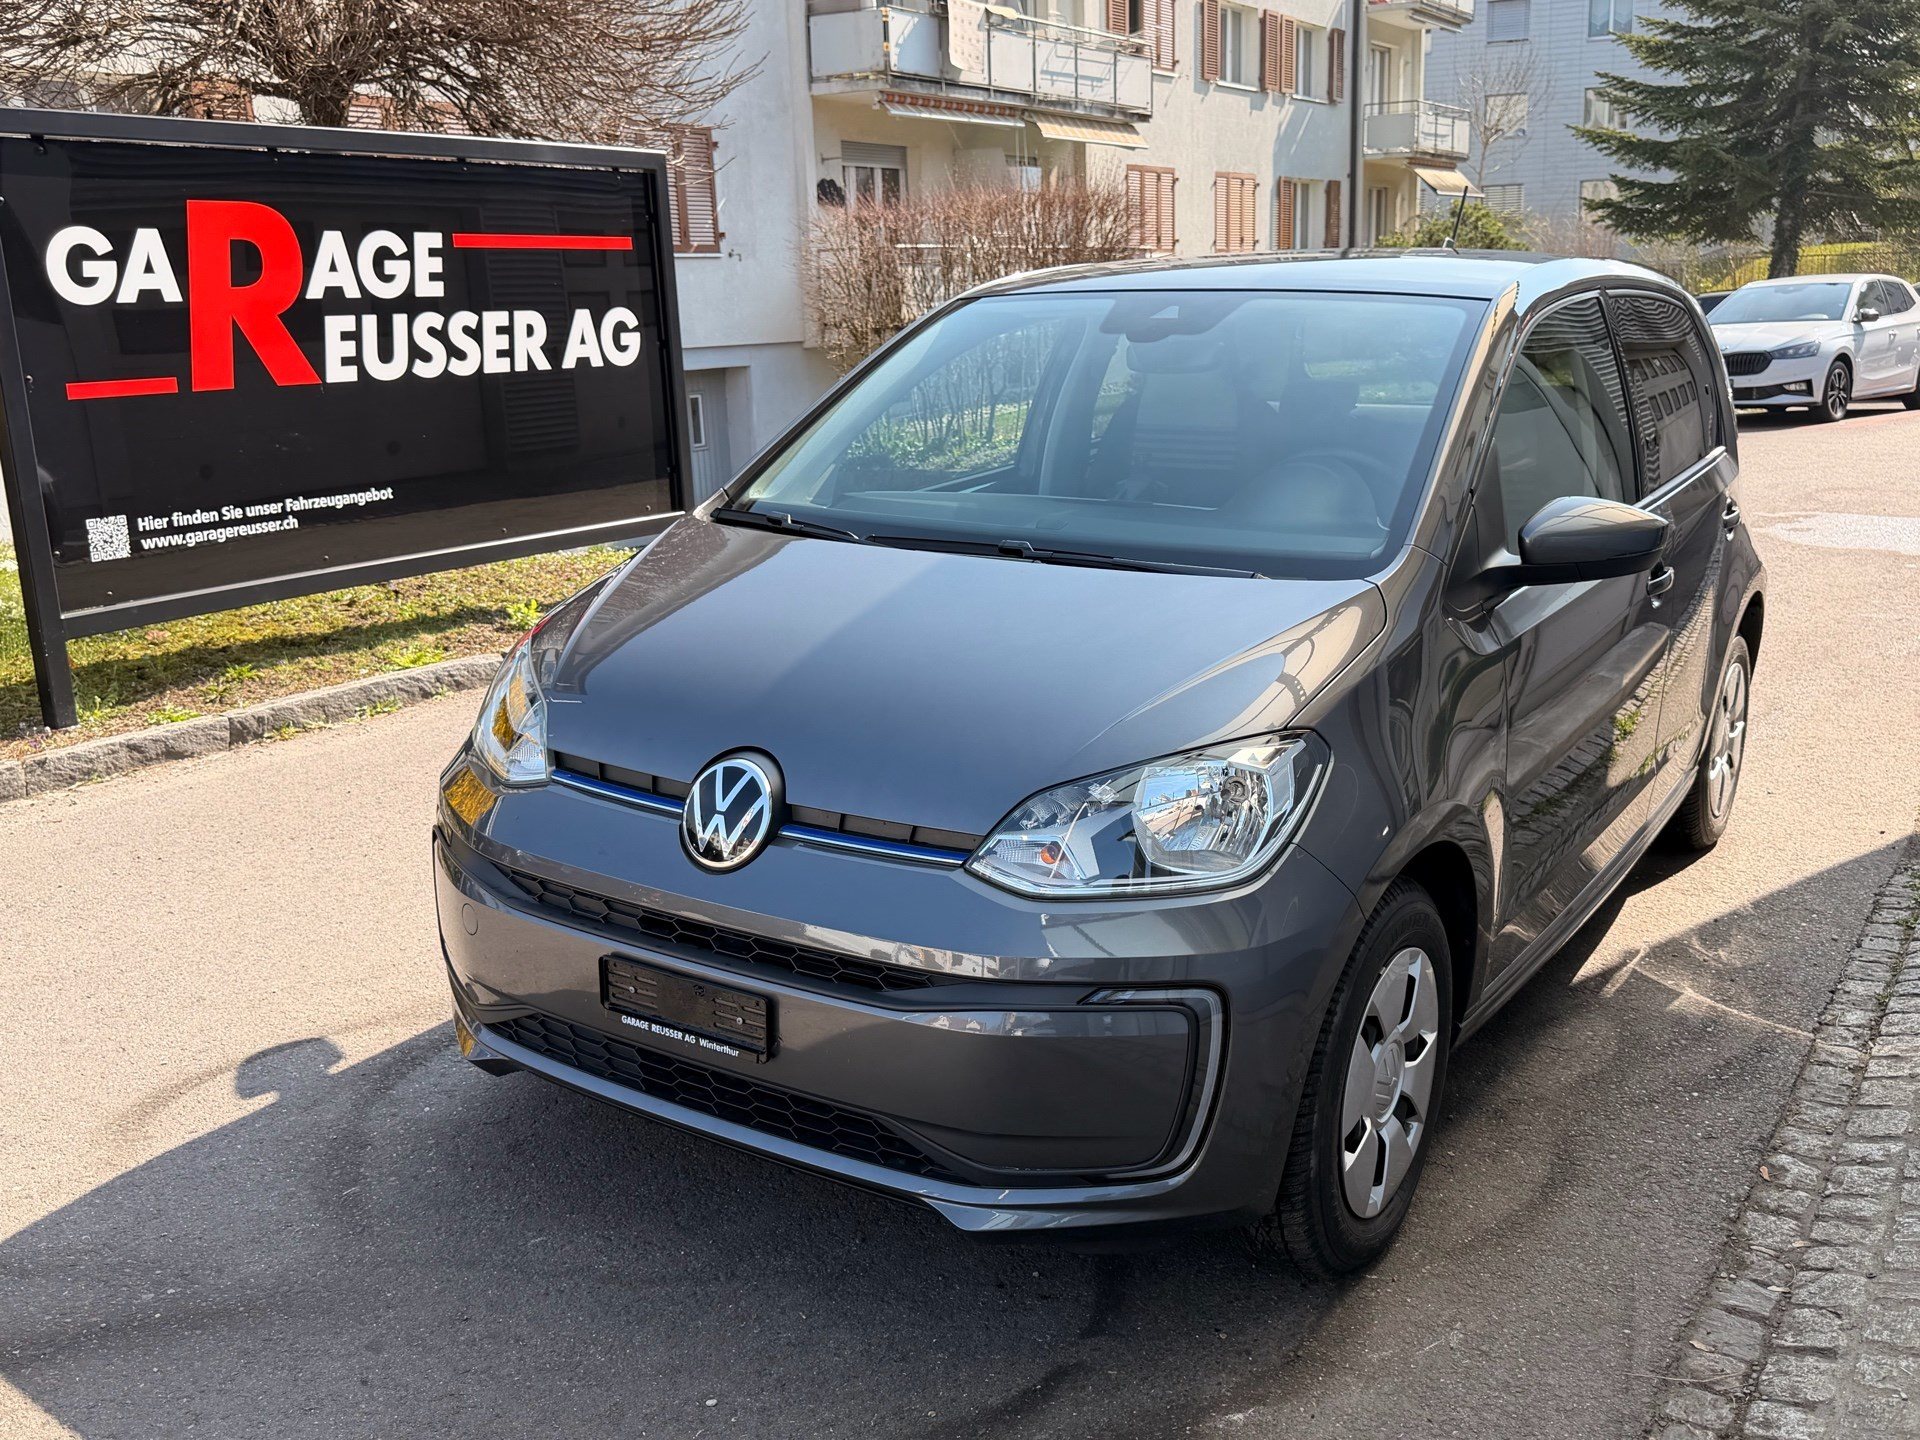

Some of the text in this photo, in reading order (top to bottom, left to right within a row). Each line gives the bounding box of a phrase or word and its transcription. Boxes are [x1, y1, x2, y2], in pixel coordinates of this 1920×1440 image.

[46, 200, 445, 391] GARAGE
[561, 306, 641, 369] AG
[137, 487, 394, 532] Hier finden Sie unser Fahrzeugangebot
[142, 516, 299, 550] www.garagereusser.ch
[621, 1015, 740, 1057] GARAGE REUSSER AG Winterthur
